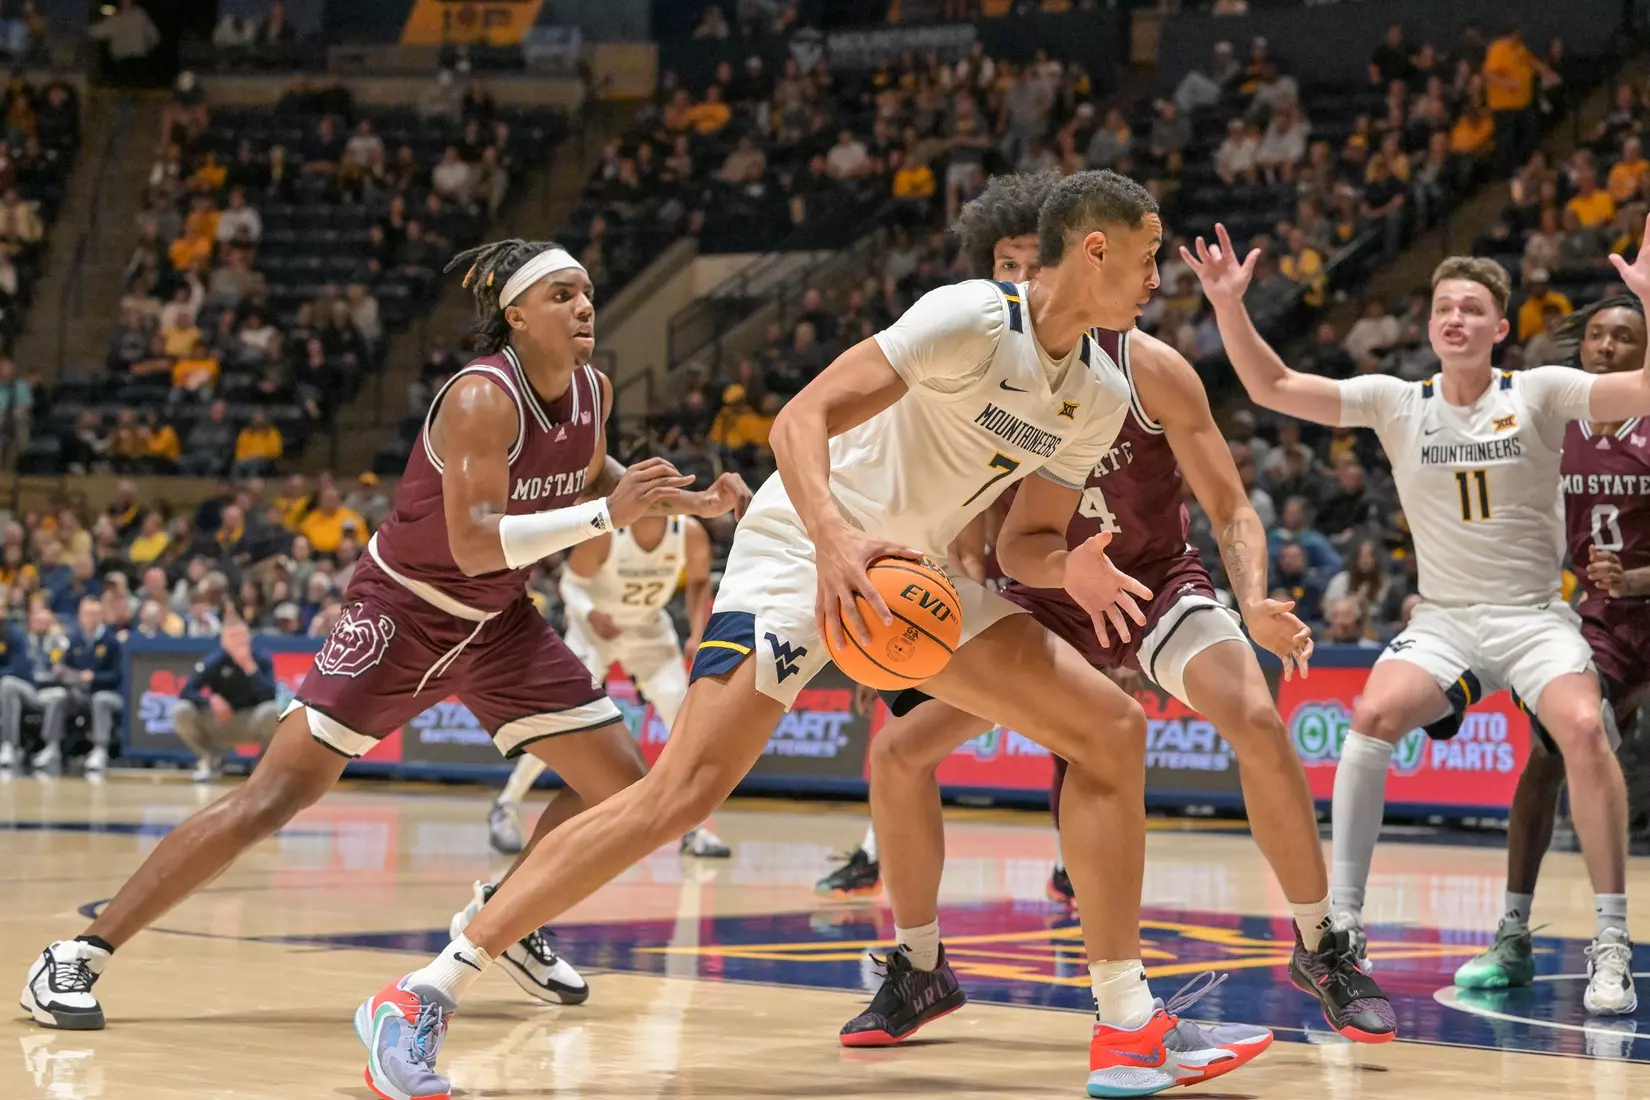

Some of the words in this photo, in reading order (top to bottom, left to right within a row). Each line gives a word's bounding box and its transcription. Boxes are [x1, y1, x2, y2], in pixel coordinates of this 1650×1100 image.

[974, 402, 1063, 458] MOUNTAINEERS
[1421, 437, 1522, 465] MOUNTAINEERS
[510, 477, 542, 500] MO
[960, 448, 1022, 508] 7
[1454, 468, 1492, 522] 11
[1560, 474, 1584, 495] MO
[1587, 474, 1650, 495] STATE
[1590, 503, 1624, 552] 0
[621, 581, 665, 607] 22
[899, 583, 952, 622] EVO
[1431, 742, 1515, 772] PARTS
